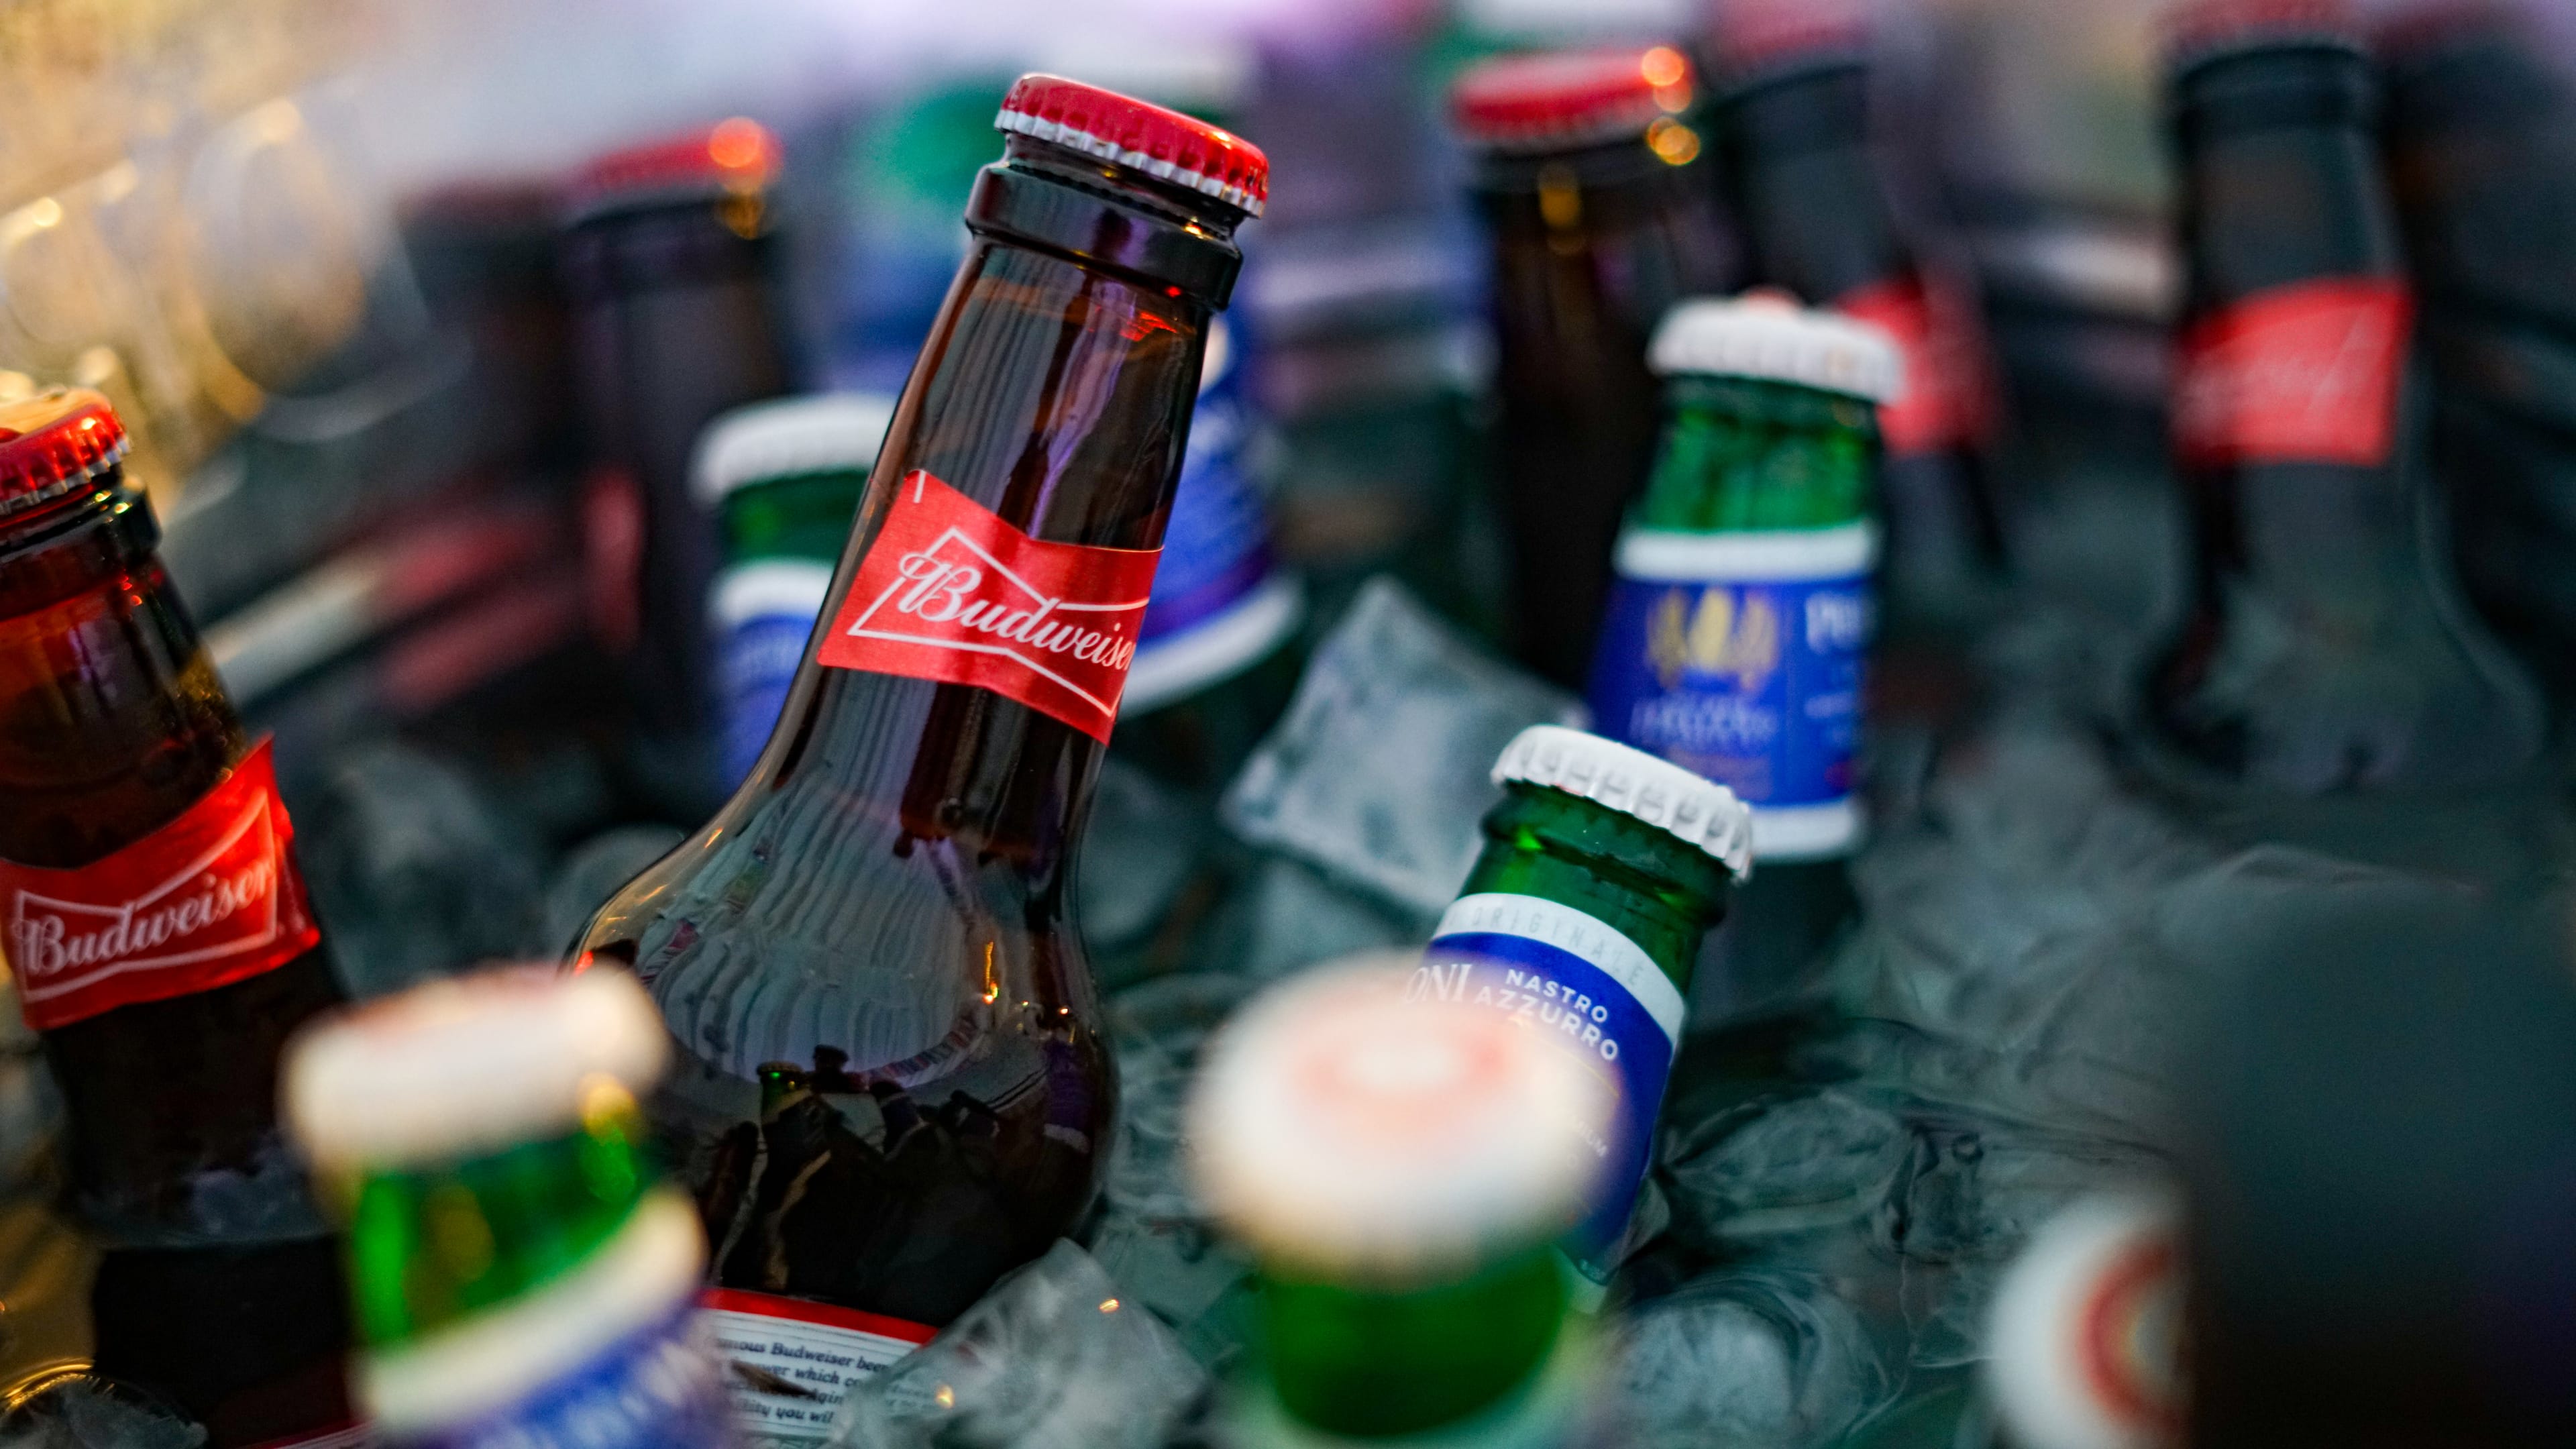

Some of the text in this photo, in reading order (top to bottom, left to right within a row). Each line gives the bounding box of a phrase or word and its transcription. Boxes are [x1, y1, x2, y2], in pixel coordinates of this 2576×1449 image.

[12, 856, 274, 975] Budweiser
[1401, 962, 1473, 1004] ONI
[1505, 969, 1608, 1024] NASTRO
[1473, 985, 1619, 1061] AZZURRO
[770, 1341, 855, 1368] Budweiser
[794, 1366, 840, 1385] which
[775, 1407, 806, 1419] you
